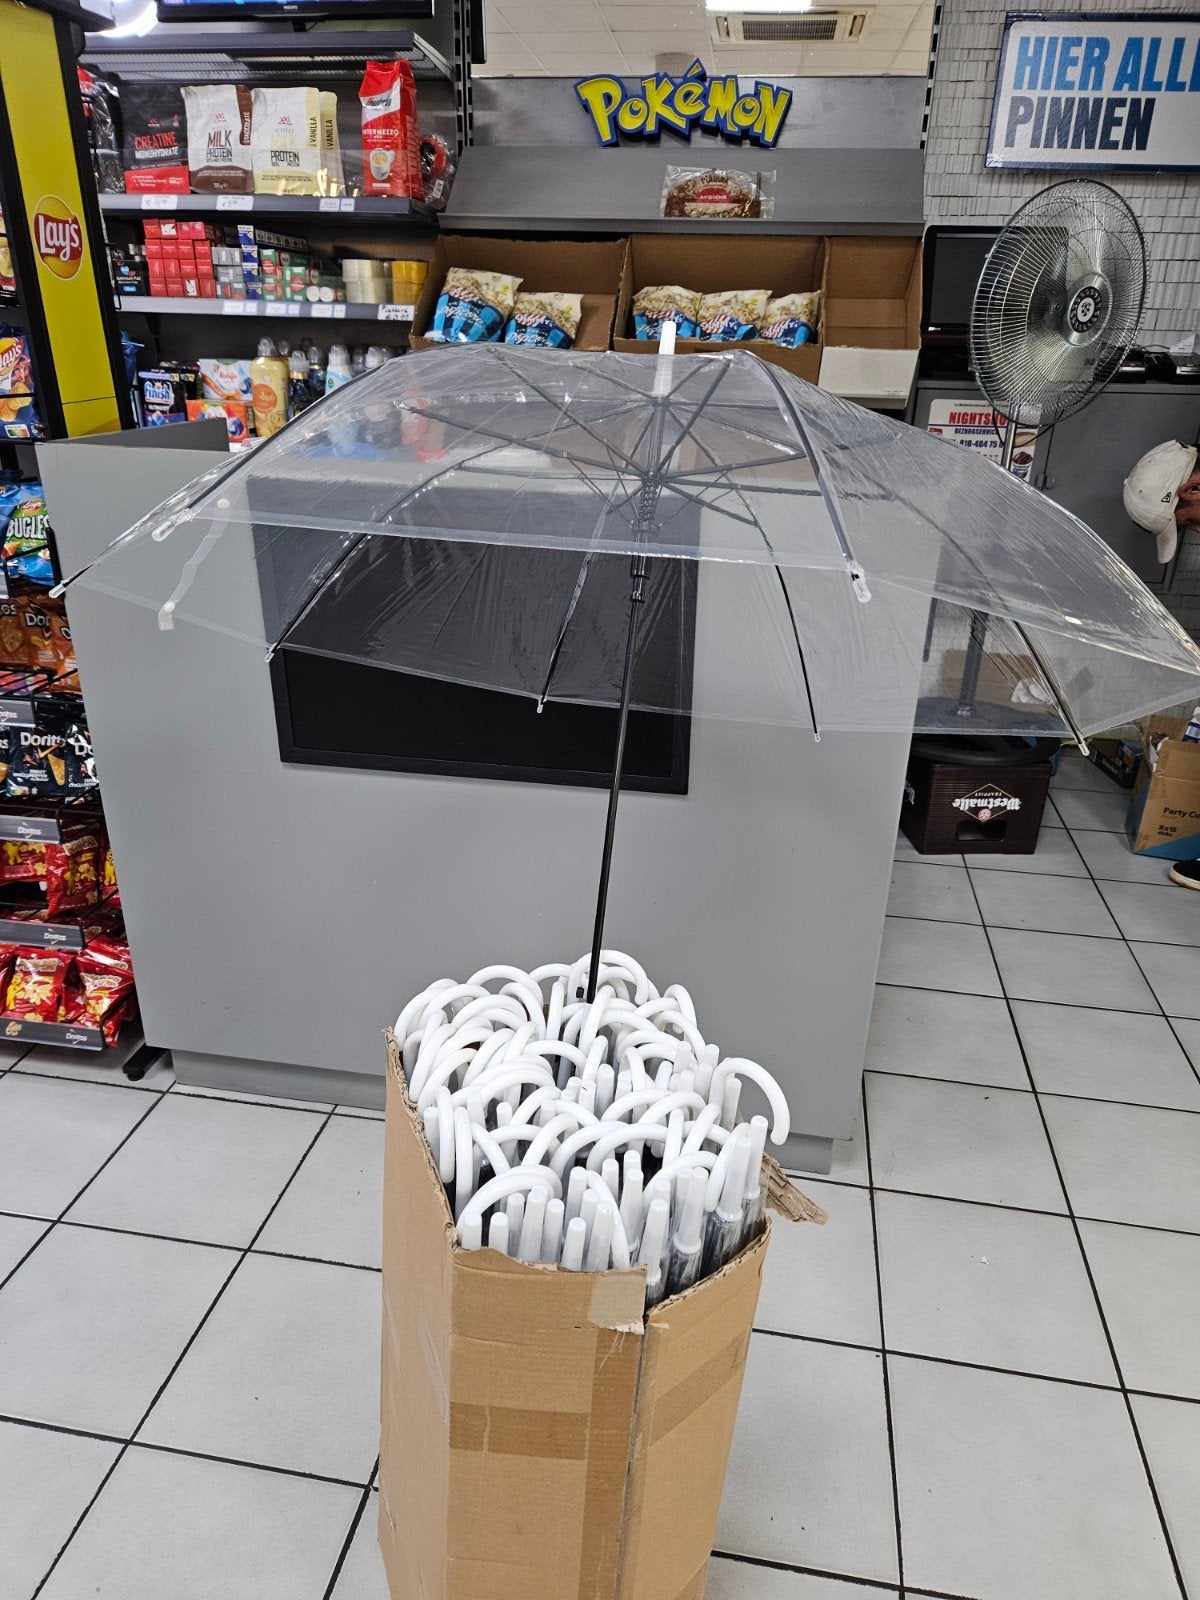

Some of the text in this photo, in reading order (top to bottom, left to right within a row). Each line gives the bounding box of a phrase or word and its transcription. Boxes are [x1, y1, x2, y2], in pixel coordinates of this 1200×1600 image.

[1013, 36, 1110, 91] HIER
[1004, 96, 1156, 151] PINNEN
[134, 131, 178, 150] CREATINE
[207, 130, 232, 148] MILK
[134, 146, 179, 160] MONOHYDRATE
[206, 147, 233, 158] PROTEIN
[270, 150, 300, 163] PROTEIN
[38, 215, 80, 262] Lay's
[0, 342, 22, 369] ay's
[220, 371, 238, 381] Robijn
[952, 797, 1022, 811] Westmalle
[1163, 806, 1188, 818] Party
[17, 826, 42, 835] Doritos
[43, 932, 67, 941] Doritos
[65, 1033, 88, 1042] Doritos
